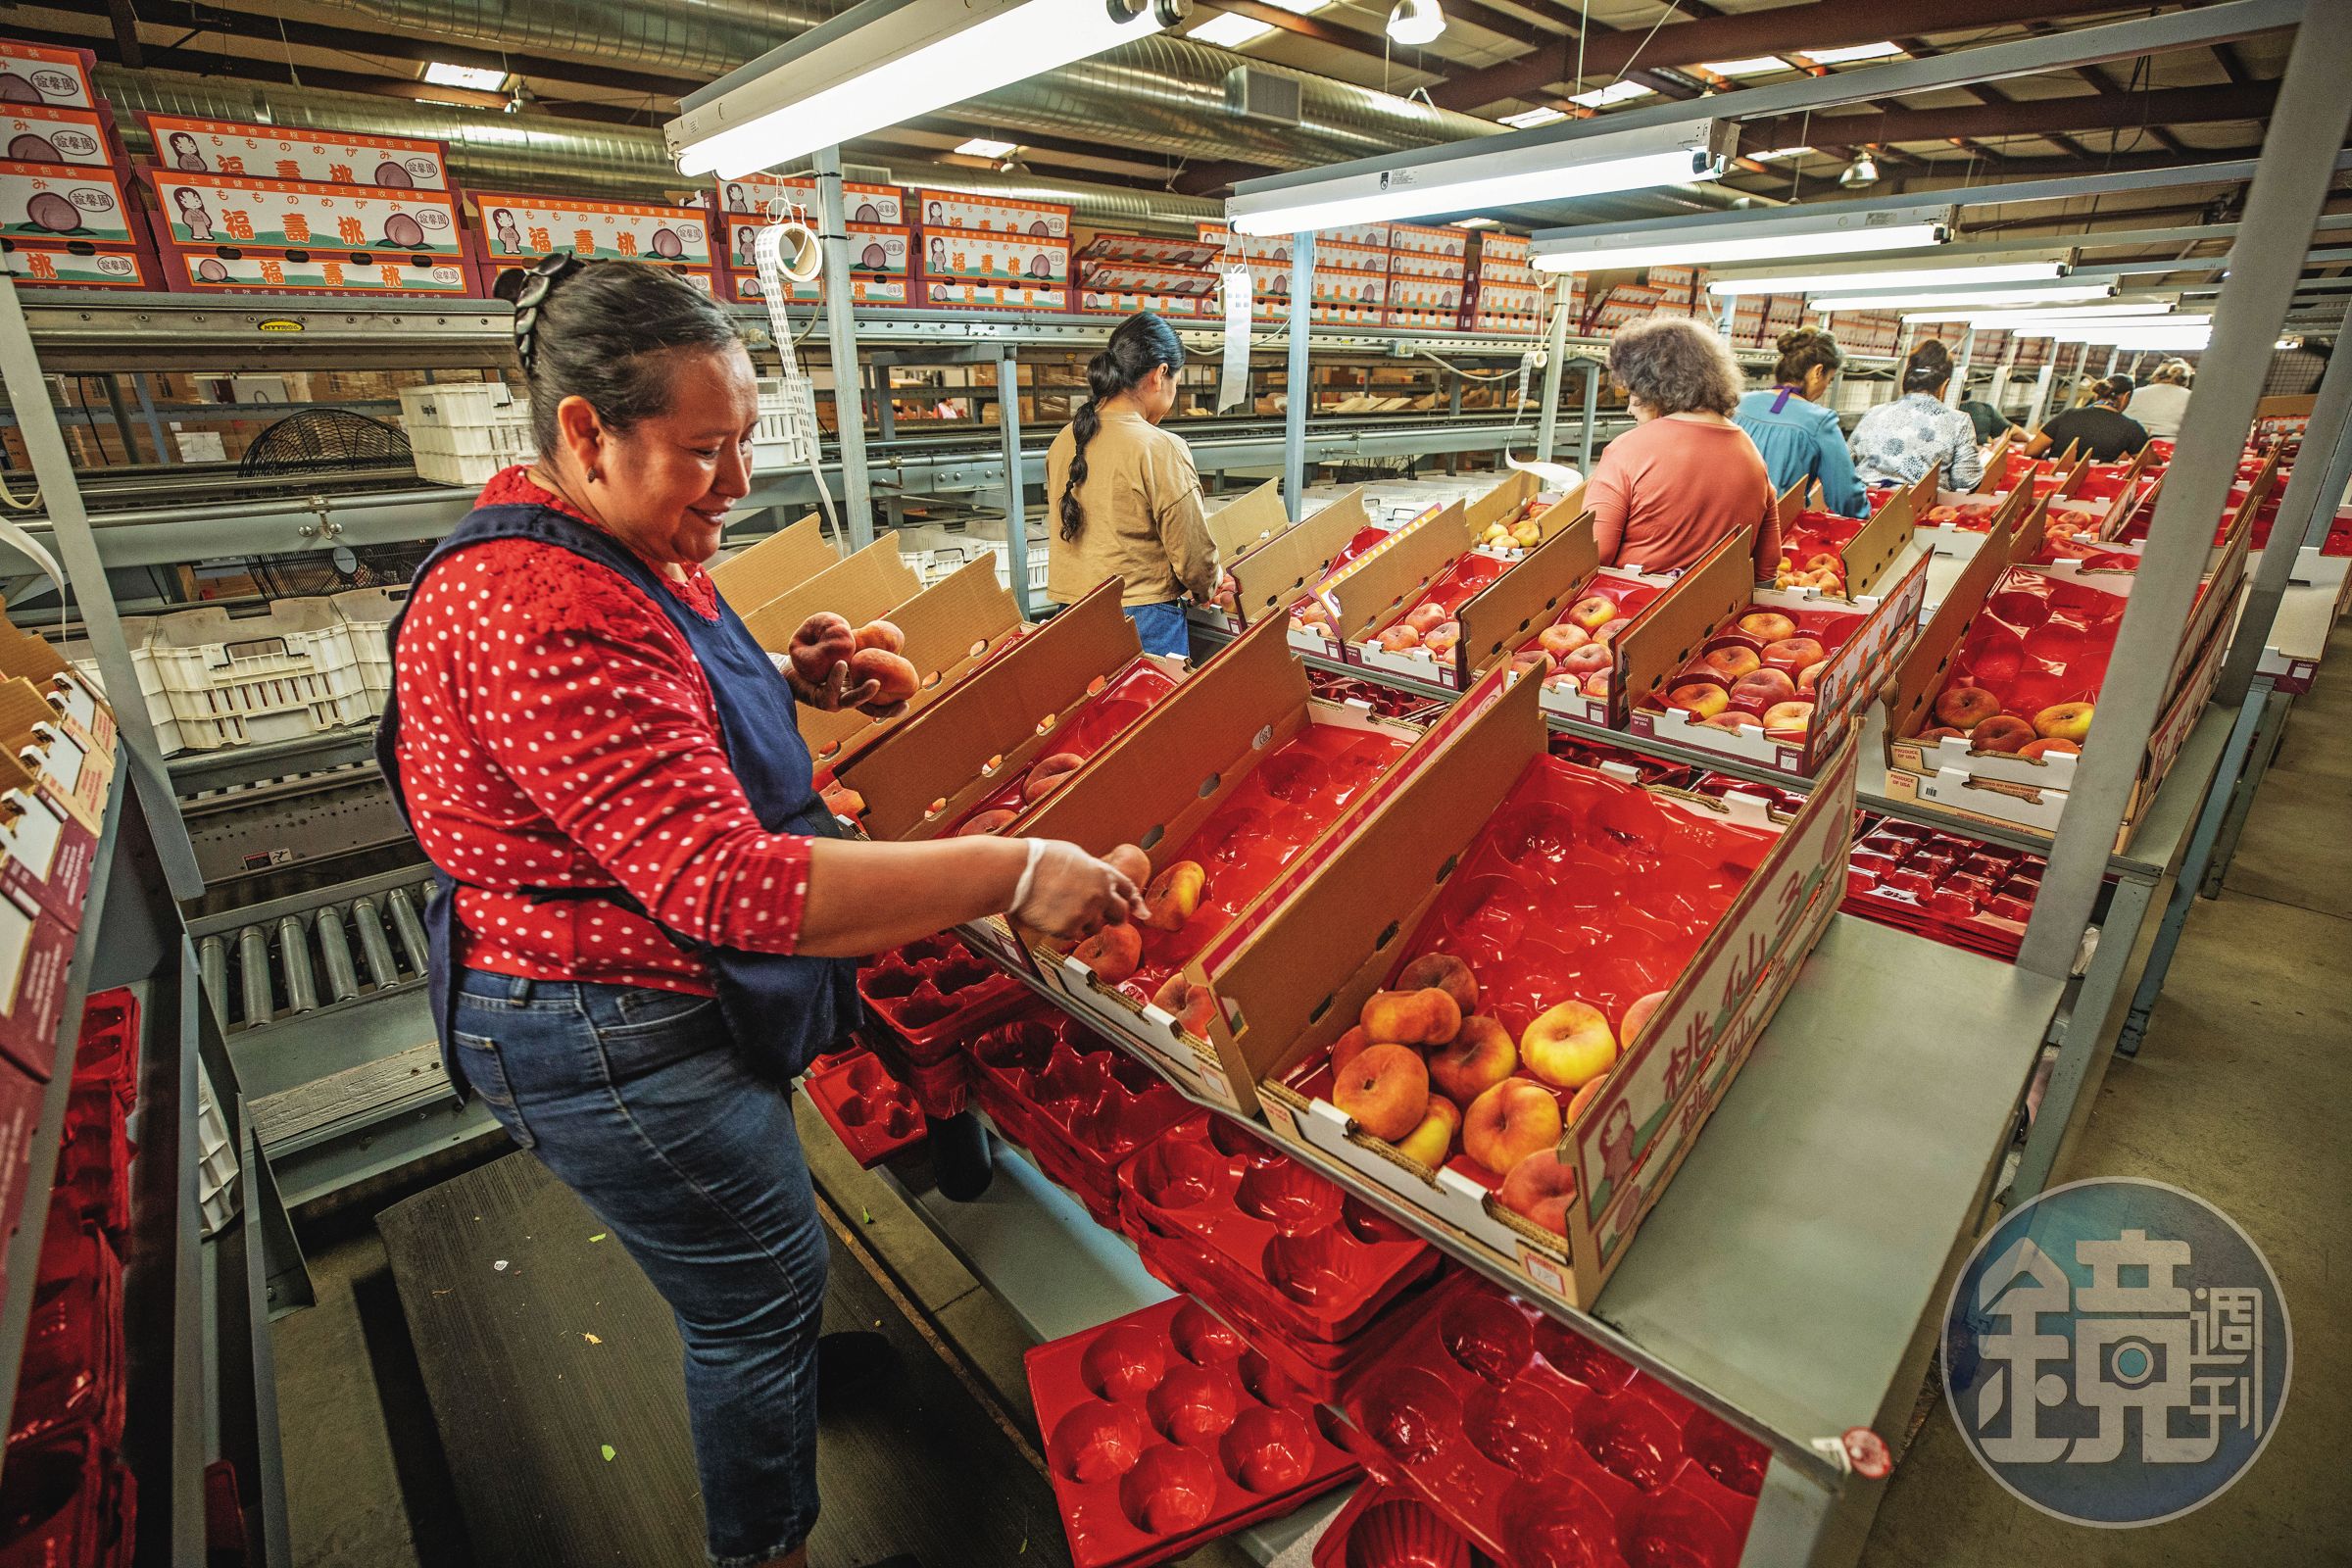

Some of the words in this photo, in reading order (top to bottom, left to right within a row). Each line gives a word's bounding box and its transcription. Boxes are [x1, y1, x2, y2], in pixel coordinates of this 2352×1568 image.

[211, 134, 392, 160] もものめがみ
[216, 189, 403, 212] もものめがみ
[221, 208, 368, 245] 福壽桃
[528, 226, 638, 257] 福壽桃
[259, 260, 403, 287] 福壽桃
[952, 251, 1020, 276] 福壽桃
[963, 286, 1034, 306] 福壽桃
[1890, 773, 1913, 783] PRODUCE
